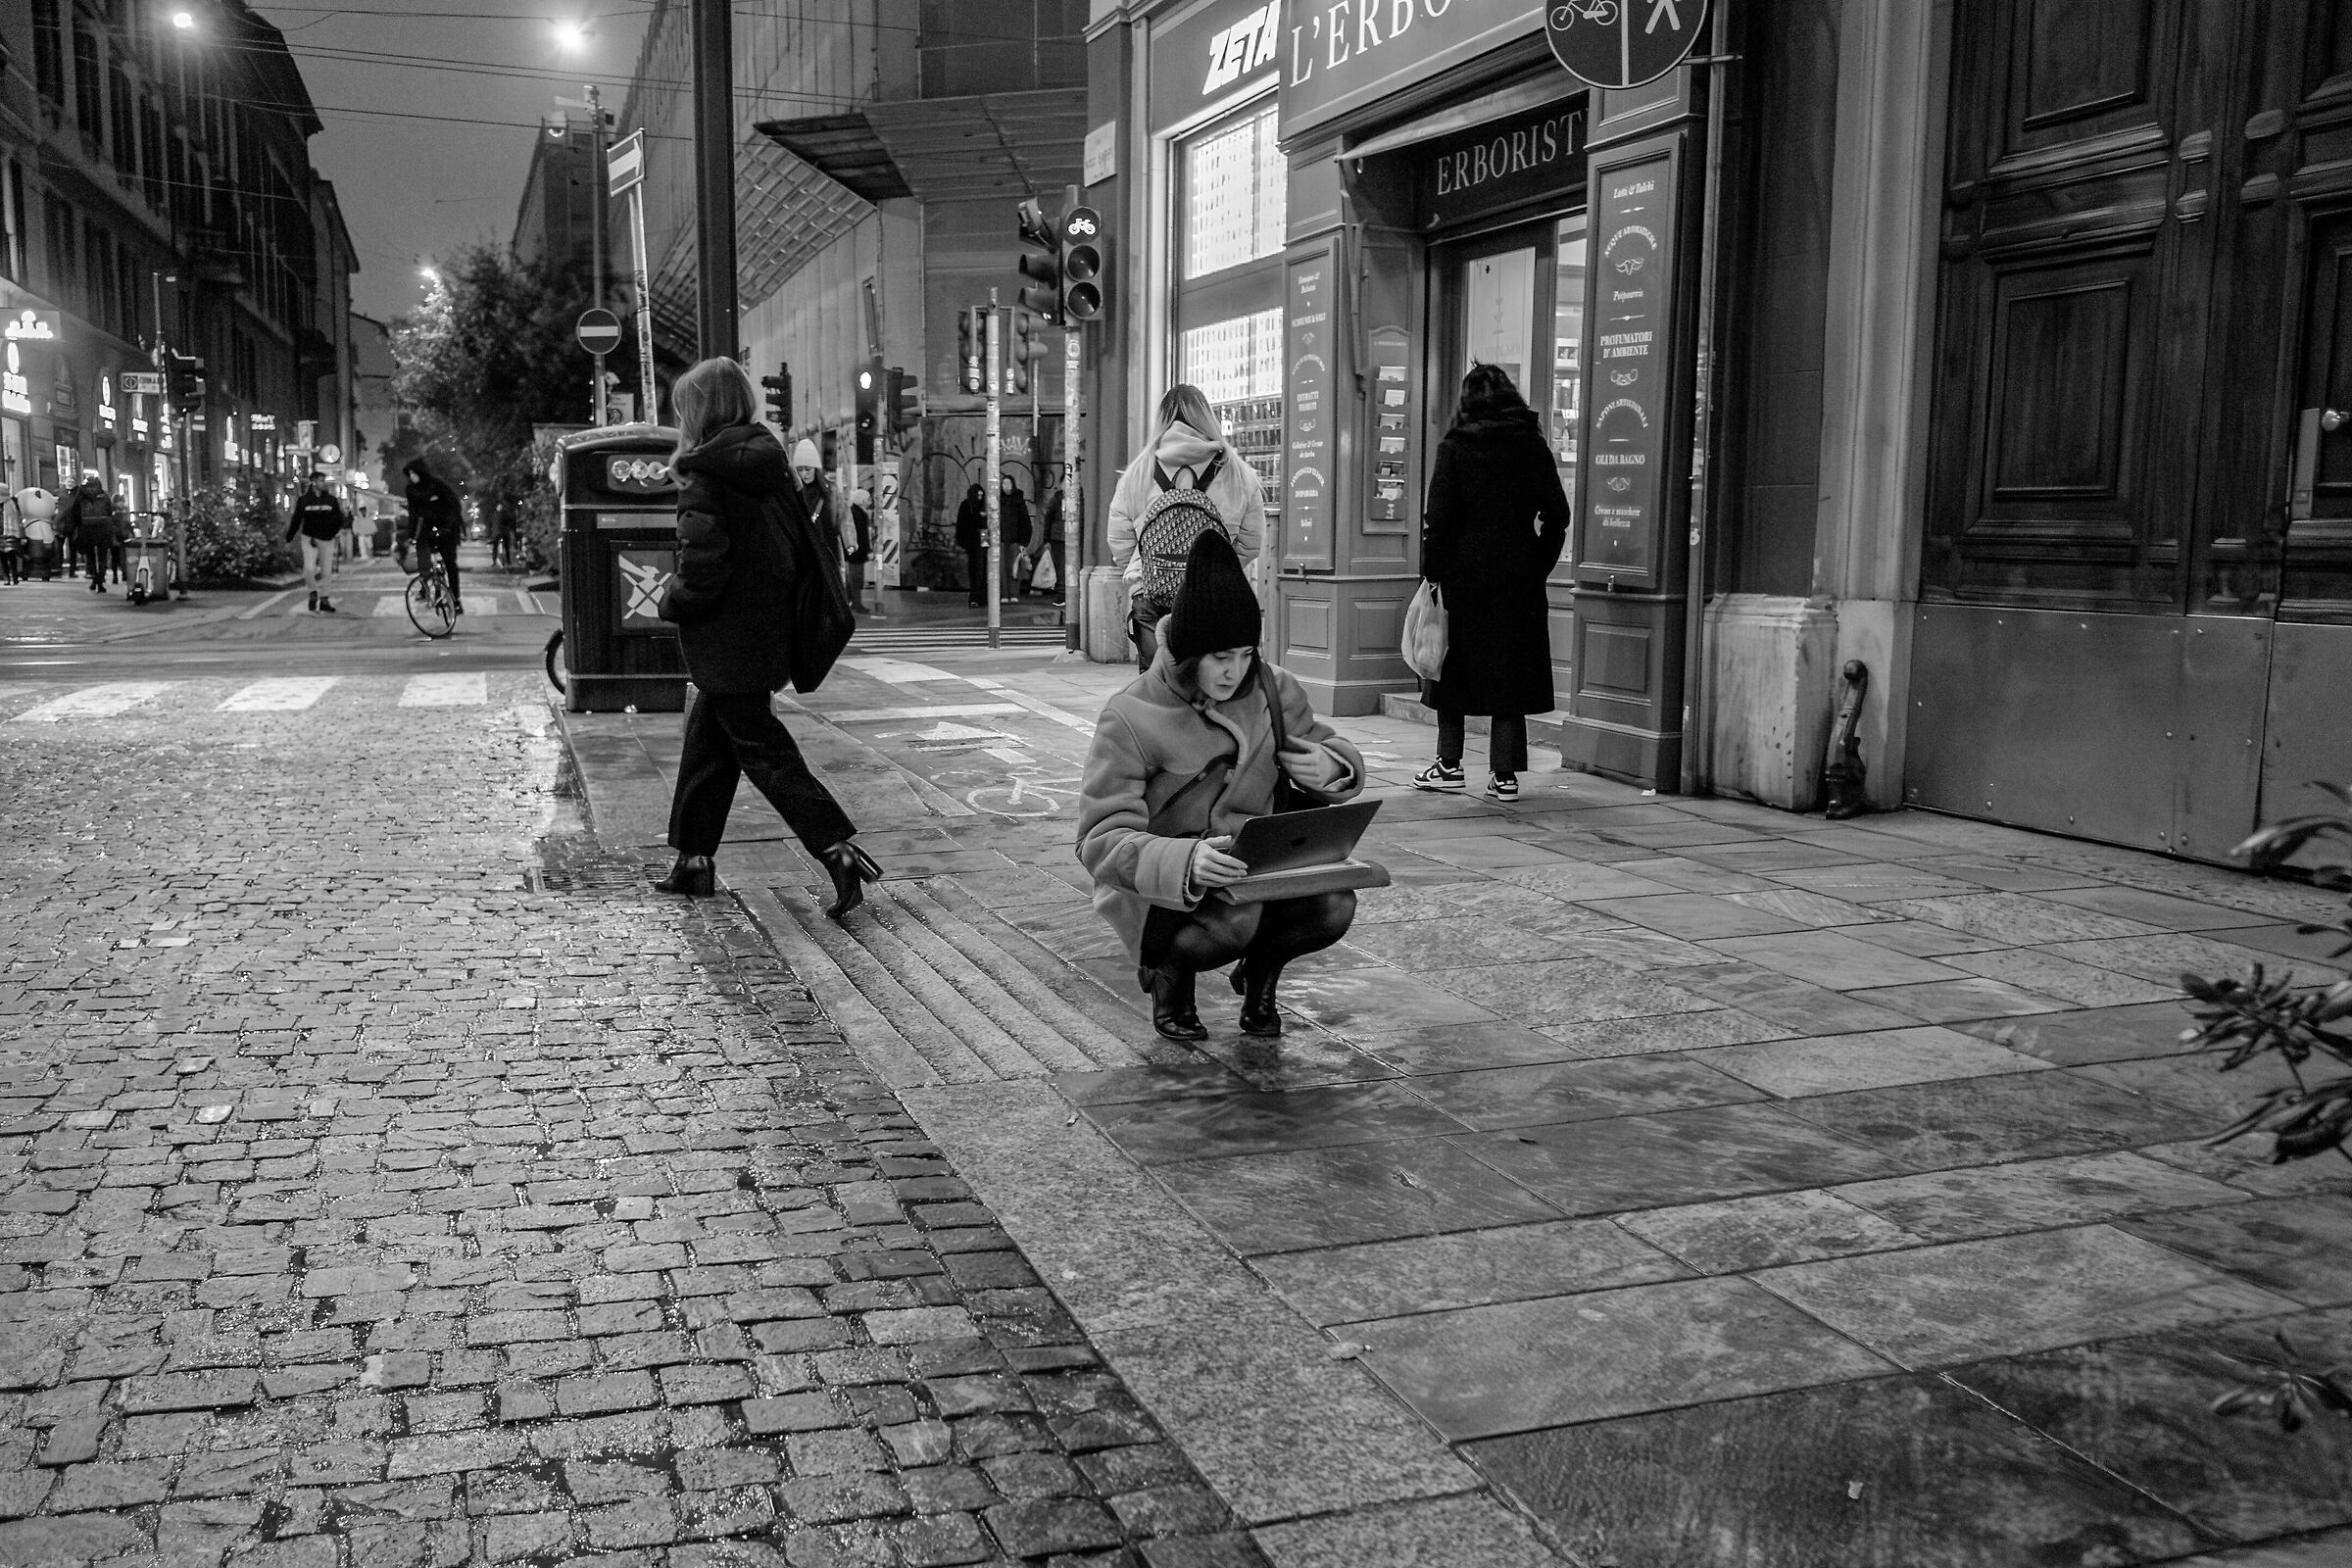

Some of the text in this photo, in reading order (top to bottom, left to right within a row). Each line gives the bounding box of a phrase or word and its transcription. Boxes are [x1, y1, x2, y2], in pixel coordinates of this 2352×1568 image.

[1201, 0, 1281, 95] ZETA
[1290, 0, 1451, 87] L'ERB
[1438, 108, 1589, 195] ERBORIST
[1599, 331, 1653, 346] PROFUMATORI
[1612, 344, 1649, 358] AMBIENTE
[1594, 454, 1645, 465] OLI DA BAGNO
